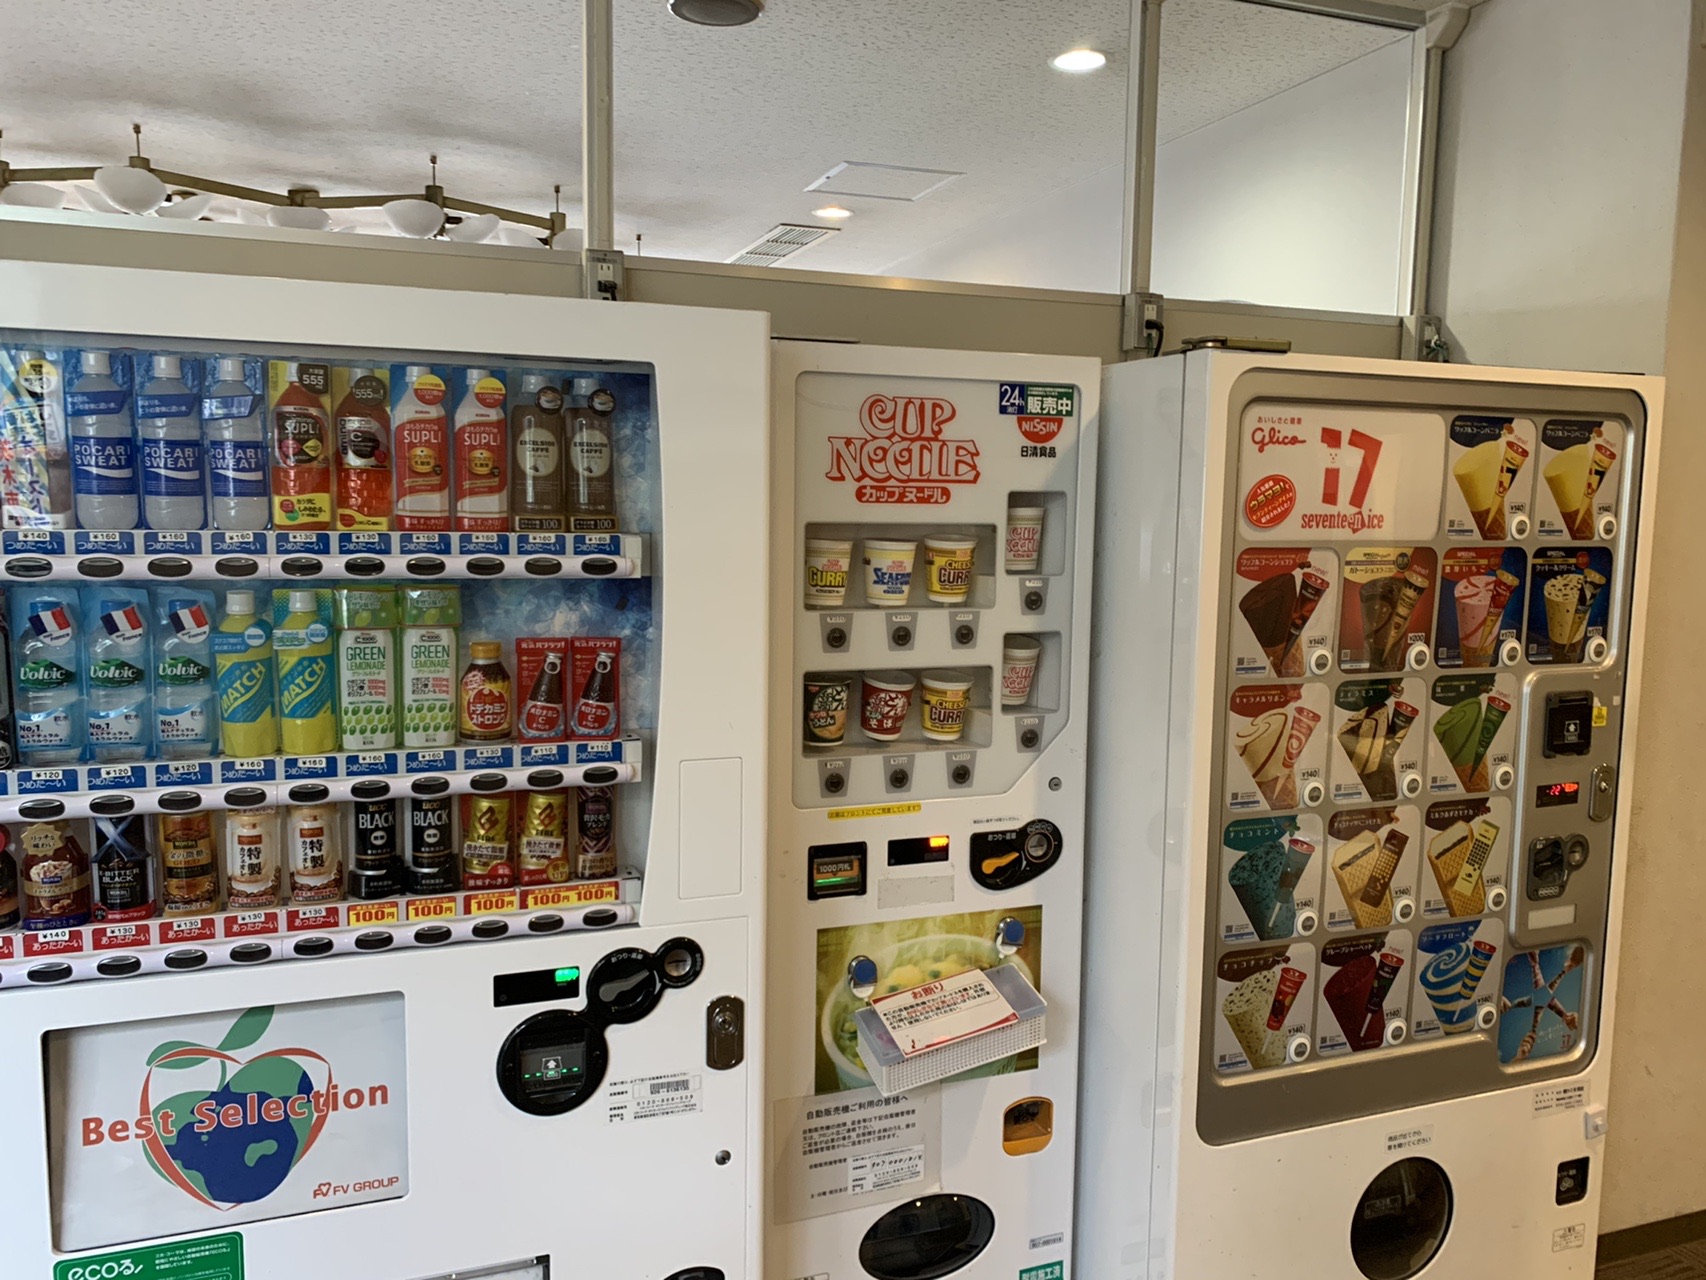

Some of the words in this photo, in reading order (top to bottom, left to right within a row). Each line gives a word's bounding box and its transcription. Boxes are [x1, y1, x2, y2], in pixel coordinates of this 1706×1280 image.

[302, 374, 324, 385] 555
[1001, 385, 1025, 406] 24h
[1027, 396, 1072, 415] 販売中
[859, 393, 956, 439] CUP
[1257, 416, 1303, 425] おいしさと健康
[1021, 418, 1058, 434] NISSIN
[339, 418, 348, 456] amino
[403, 432, 442, 443] SUPLI
[464, 433, 500, 446] SUPLI
[1251, 427, 1307, 453] Glico
[74, 444, 131, 456] POCARI
[144, 446, 199, 458] POCARI
[208, 448, 261, 460] POCARI
[1020, 446, 1057, 458] 日清食品
[75, 455, 128, 466] SWEAT
[145, 457, 195, 469] SWEAT
[211, 458, 256, 470] SWEAT
[825, 436, 981, 484] NOODLE
[1320, 426, 1383, 510] 17
[861, 486, 947, 503] カップヌードル
[1301, 511, 1366, 534] seventeen
[1367, 508, 1384, 530] ice
[22, 532, 48, 540] ¥140
[92, 532, 117, 541] ¥160
[161, 533, 185, 541] ¥160
[228, 533, 251, 542] ¥160
[292, 533, 314, 541] ¥130
[355, 533, 376, 541] ¥130
[415, 533, 437, 541] ¥160
[532, 534, 552, 542] ¥160
[1008, 527, 1039, 540] CUP
[1240, 558, 1294, 566] ワッフルコーンショコラ
[808, 567, 847, 587] CURRY
[521, 641, 564, 649] 元気ハツラツ!
[574, 640, 617, 648] 元気ハツラツ!
[346, 646, 386, 662] GREEN
[411, 644, 450, 660] GREEN
[346, 660, 386, 671] LEMONADE
[411, 659, 450, 669] LEMONADE
[20, 666, 66, 681] Volvic
[90, 665, 138, 680] Volvic
[158, 664, 202, 677] Volvic
[220, 662, 266, 712] MATCH
[281, 658, 327, 708] MATCH
[1235, 694, 1286, 704] キャラメルリボン
[469, 703, 507, 713] ドデカミン
[529, 706, 557, 717] オロナミン
[581, 704, 608, 716] オロナミン
[471, 714, 505, 725] ストロング
[869, 718, 893, 728] そば
[421, 752, 442, 760] ¥160
[1493, 755, 1507, 764] ¥140
[173, 764, 197, 772] ¥120
[301, 758, 323, 767] ¥160
[1400, 763, 1416, 772] ¥140
[105, 768, 129, 776] ¥120
[1301, 769, 1317, 778] ¥140
[359, 811, 394, 829] BLACK
[413, 809, 449, 826] BLACK
[1229, 828, 1279, 839] チョコミント
[308, 839, 324, 869] 特製
[247, 846, 262, 876] 特製
[819, 863, 851, 873] 1000円札
[1486, 876, 1500, 885] ¥140
[575, 888, 613, 900] 100円
[1394, 888, 1410, 896] ¥140
[474, 898, 515, 911] 100円
[531, 893, 571, 906] 100円
[1296, 899, 1312, 908] ¥140
[241, 912, 263, 921] ¥130
[302, 908, 323, 916] ¥130
[353, 910, 395, 923] 100円
[412, 905, 453, 917] 100円
[176, 920, 199, 929] ¥130
[42, 931, 67, 939] ¥140
[110, 927, 133, 935] ¥130
[1223, 957, 1273, 971] チョコチップ
[911, 982, 944, 999] お断り
[1385, 1009, 1400, 1018] ¥140
[1288, 1025, 1304, 1035] ¥140
[807, 1095, 909, 1120] 自動販売機ご利用の皆様へ
[82, 1108, 177, 1147] Best
[194, 1083, 389, 1132] Selection
[333, 1184, 350, 1196] FV
[353, 1175, 399, 1193] GROUP
